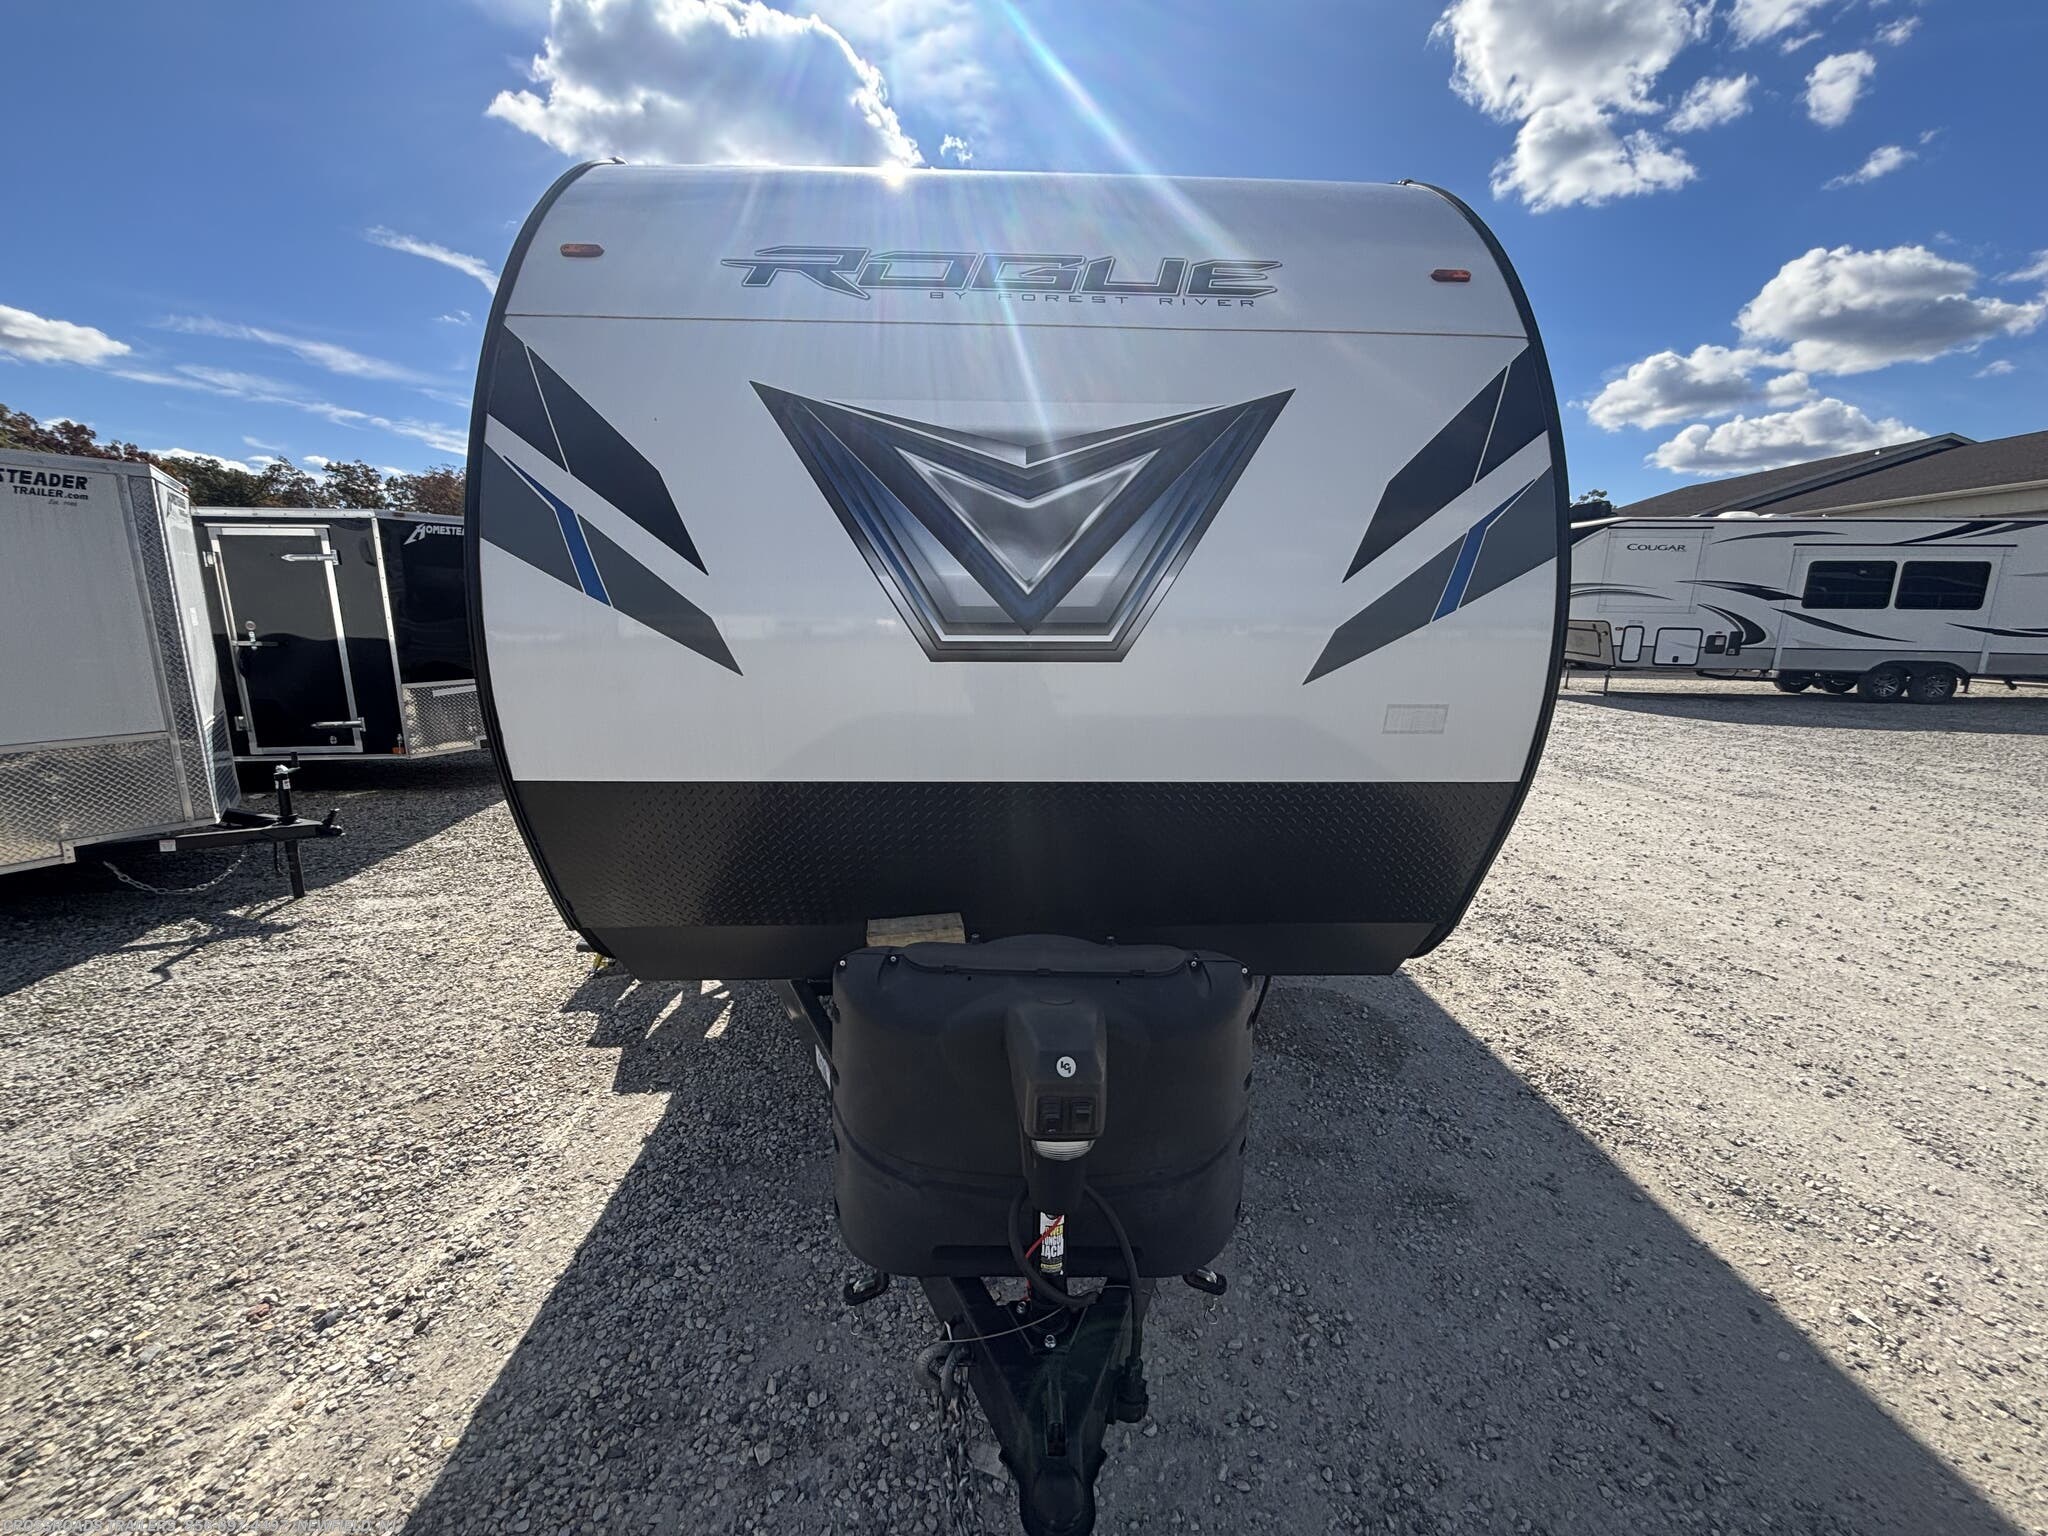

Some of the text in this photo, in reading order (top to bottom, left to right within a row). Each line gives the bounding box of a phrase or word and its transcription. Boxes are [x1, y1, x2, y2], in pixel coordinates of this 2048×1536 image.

[720, 245, 1282, 300] ROGUE
[930, 291, 1256, 308] BY FOREST RIVER
[1627, 543, 1687, 552] COUGAR
